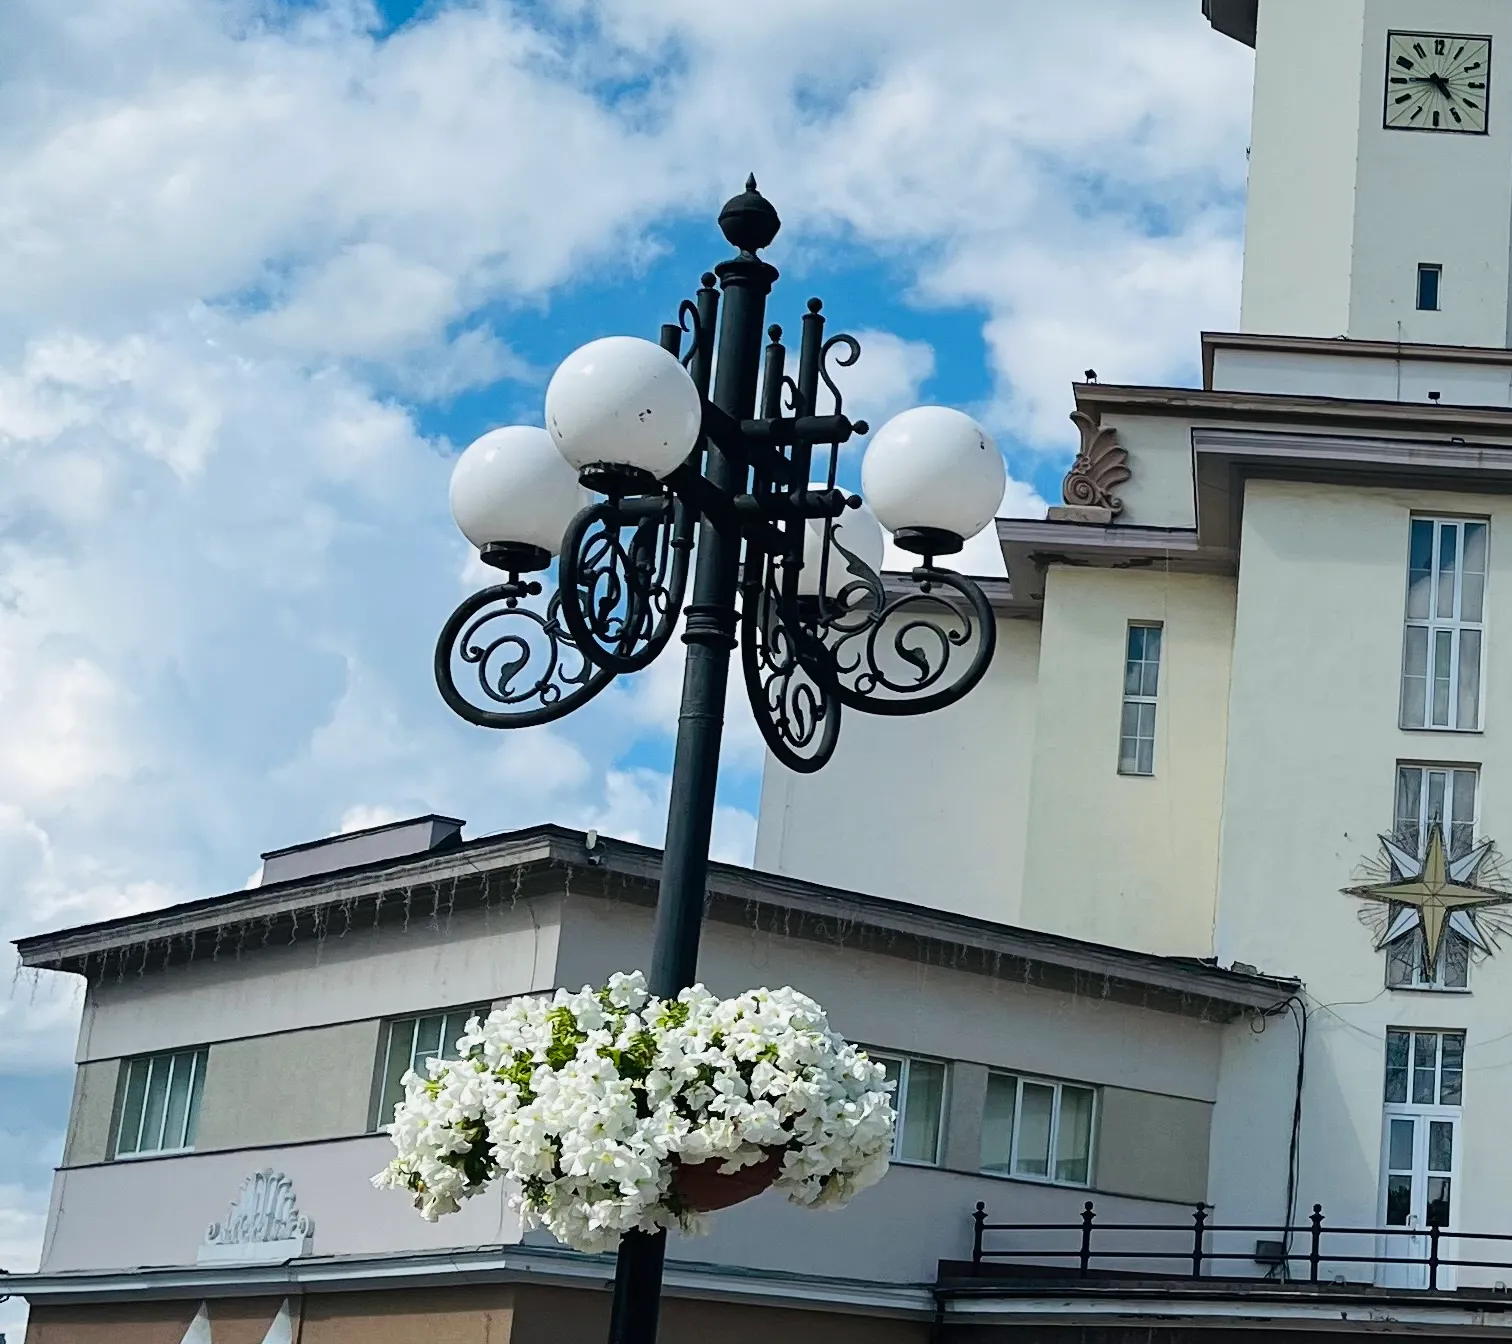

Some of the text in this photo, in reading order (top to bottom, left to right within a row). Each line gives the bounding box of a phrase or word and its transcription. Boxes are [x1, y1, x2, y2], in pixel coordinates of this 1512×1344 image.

[1413, 42, 1427, 59] 11
[1434, 39, 1445, 55] 12
[1453, 46, 1464, 61] 1
[1464, 62, 1480, 73] 2
